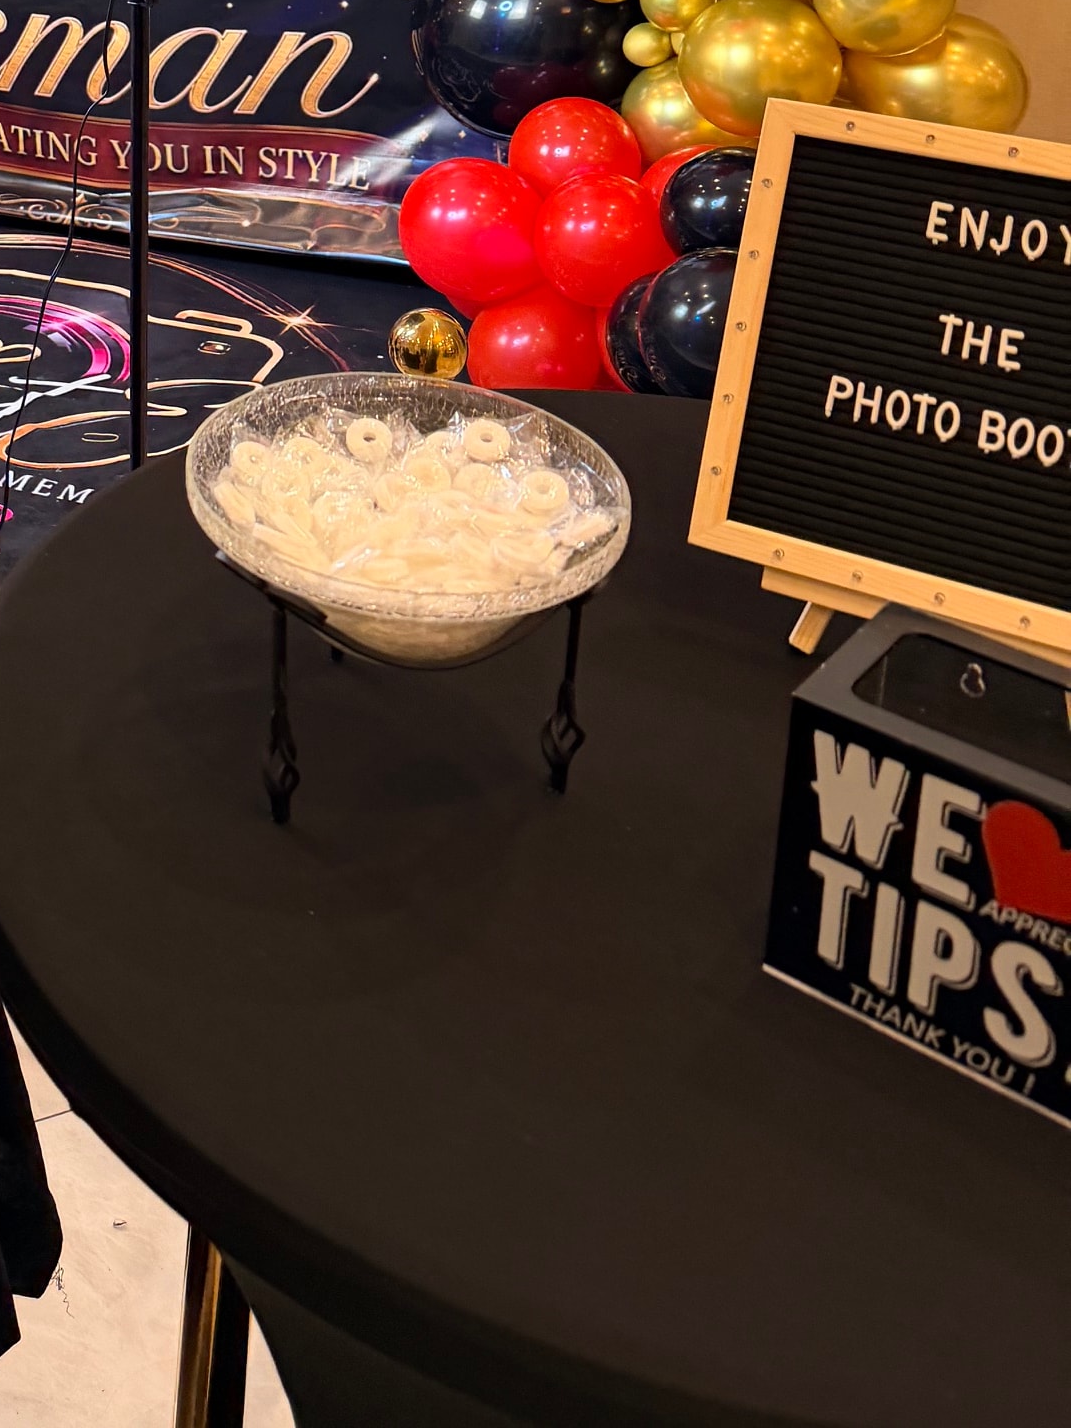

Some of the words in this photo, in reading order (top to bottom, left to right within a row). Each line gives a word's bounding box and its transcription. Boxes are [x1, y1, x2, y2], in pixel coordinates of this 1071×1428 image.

[203, 145, 245, 176] IN
[258, 146, 371, 191] STYLE
[938, 314, 1025, 372] THE
[825, 375, 962, 443] PHOTO
[978, 409, 1071, 467] BOO
[810, 728, 987, 912] WE
[808, 849, 1064, 1069] TIPS
[849, 981, 947, 1049] THANK
[951, 1034, 1017, 1085] YOU
